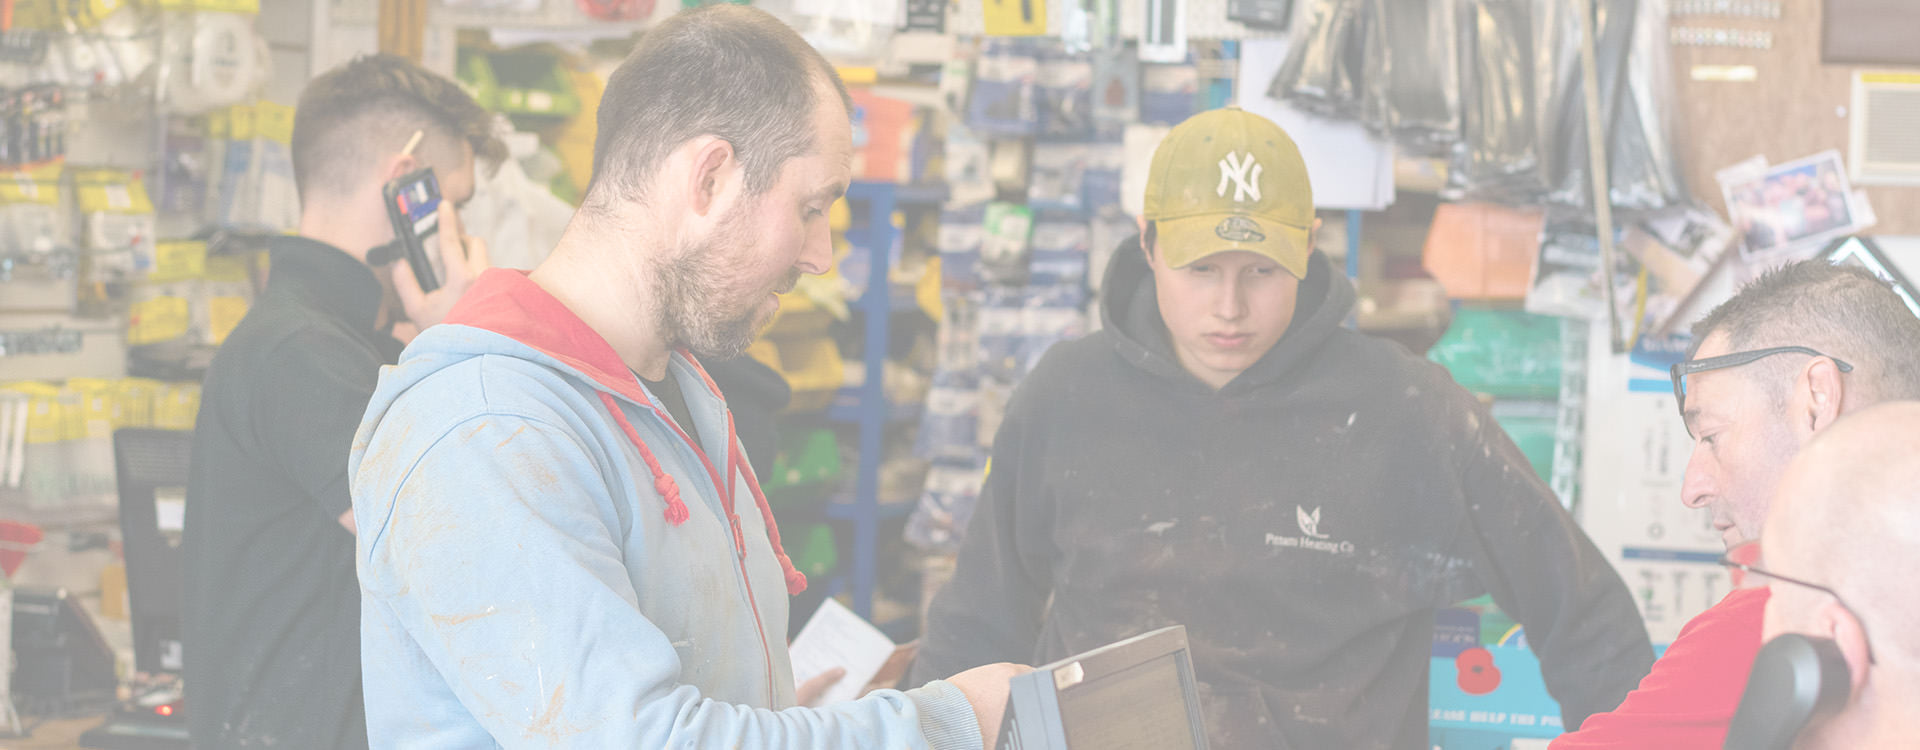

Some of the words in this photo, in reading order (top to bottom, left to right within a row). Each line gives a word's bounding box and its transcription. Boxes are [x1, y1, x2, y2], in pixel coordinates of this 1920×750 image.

[1216, 150, 1264, 203] NY
[1300, 537, 1339, 554] Heating
[1469, 710, 1507, 724] HELP
[1510, 713, 1537, 726] THE
